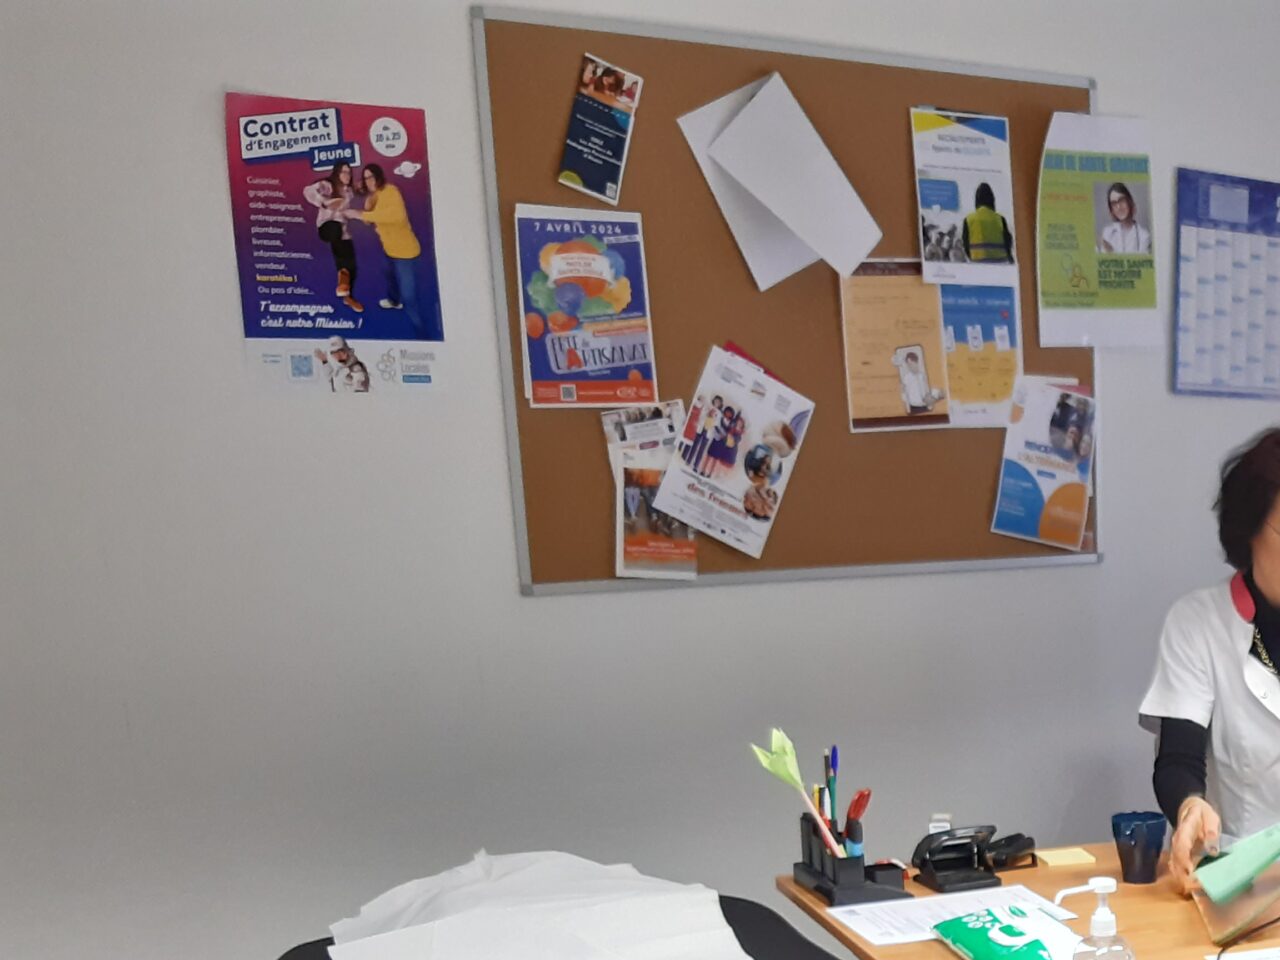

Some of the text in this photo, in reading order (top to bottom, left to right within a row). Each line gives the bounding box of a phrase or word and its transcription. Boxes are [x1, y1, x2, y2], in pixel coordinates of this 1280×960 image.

[243, 112, 330, 138] Contrat
[245, 132, 332, 151] d'Engagement
[313, 148, 352, 164] Jeune
[534, 221, 622, 234] 7 AVRIL 2024
[271, 287, 285, 296] pas
[315, 317, 355, 329] Mission
